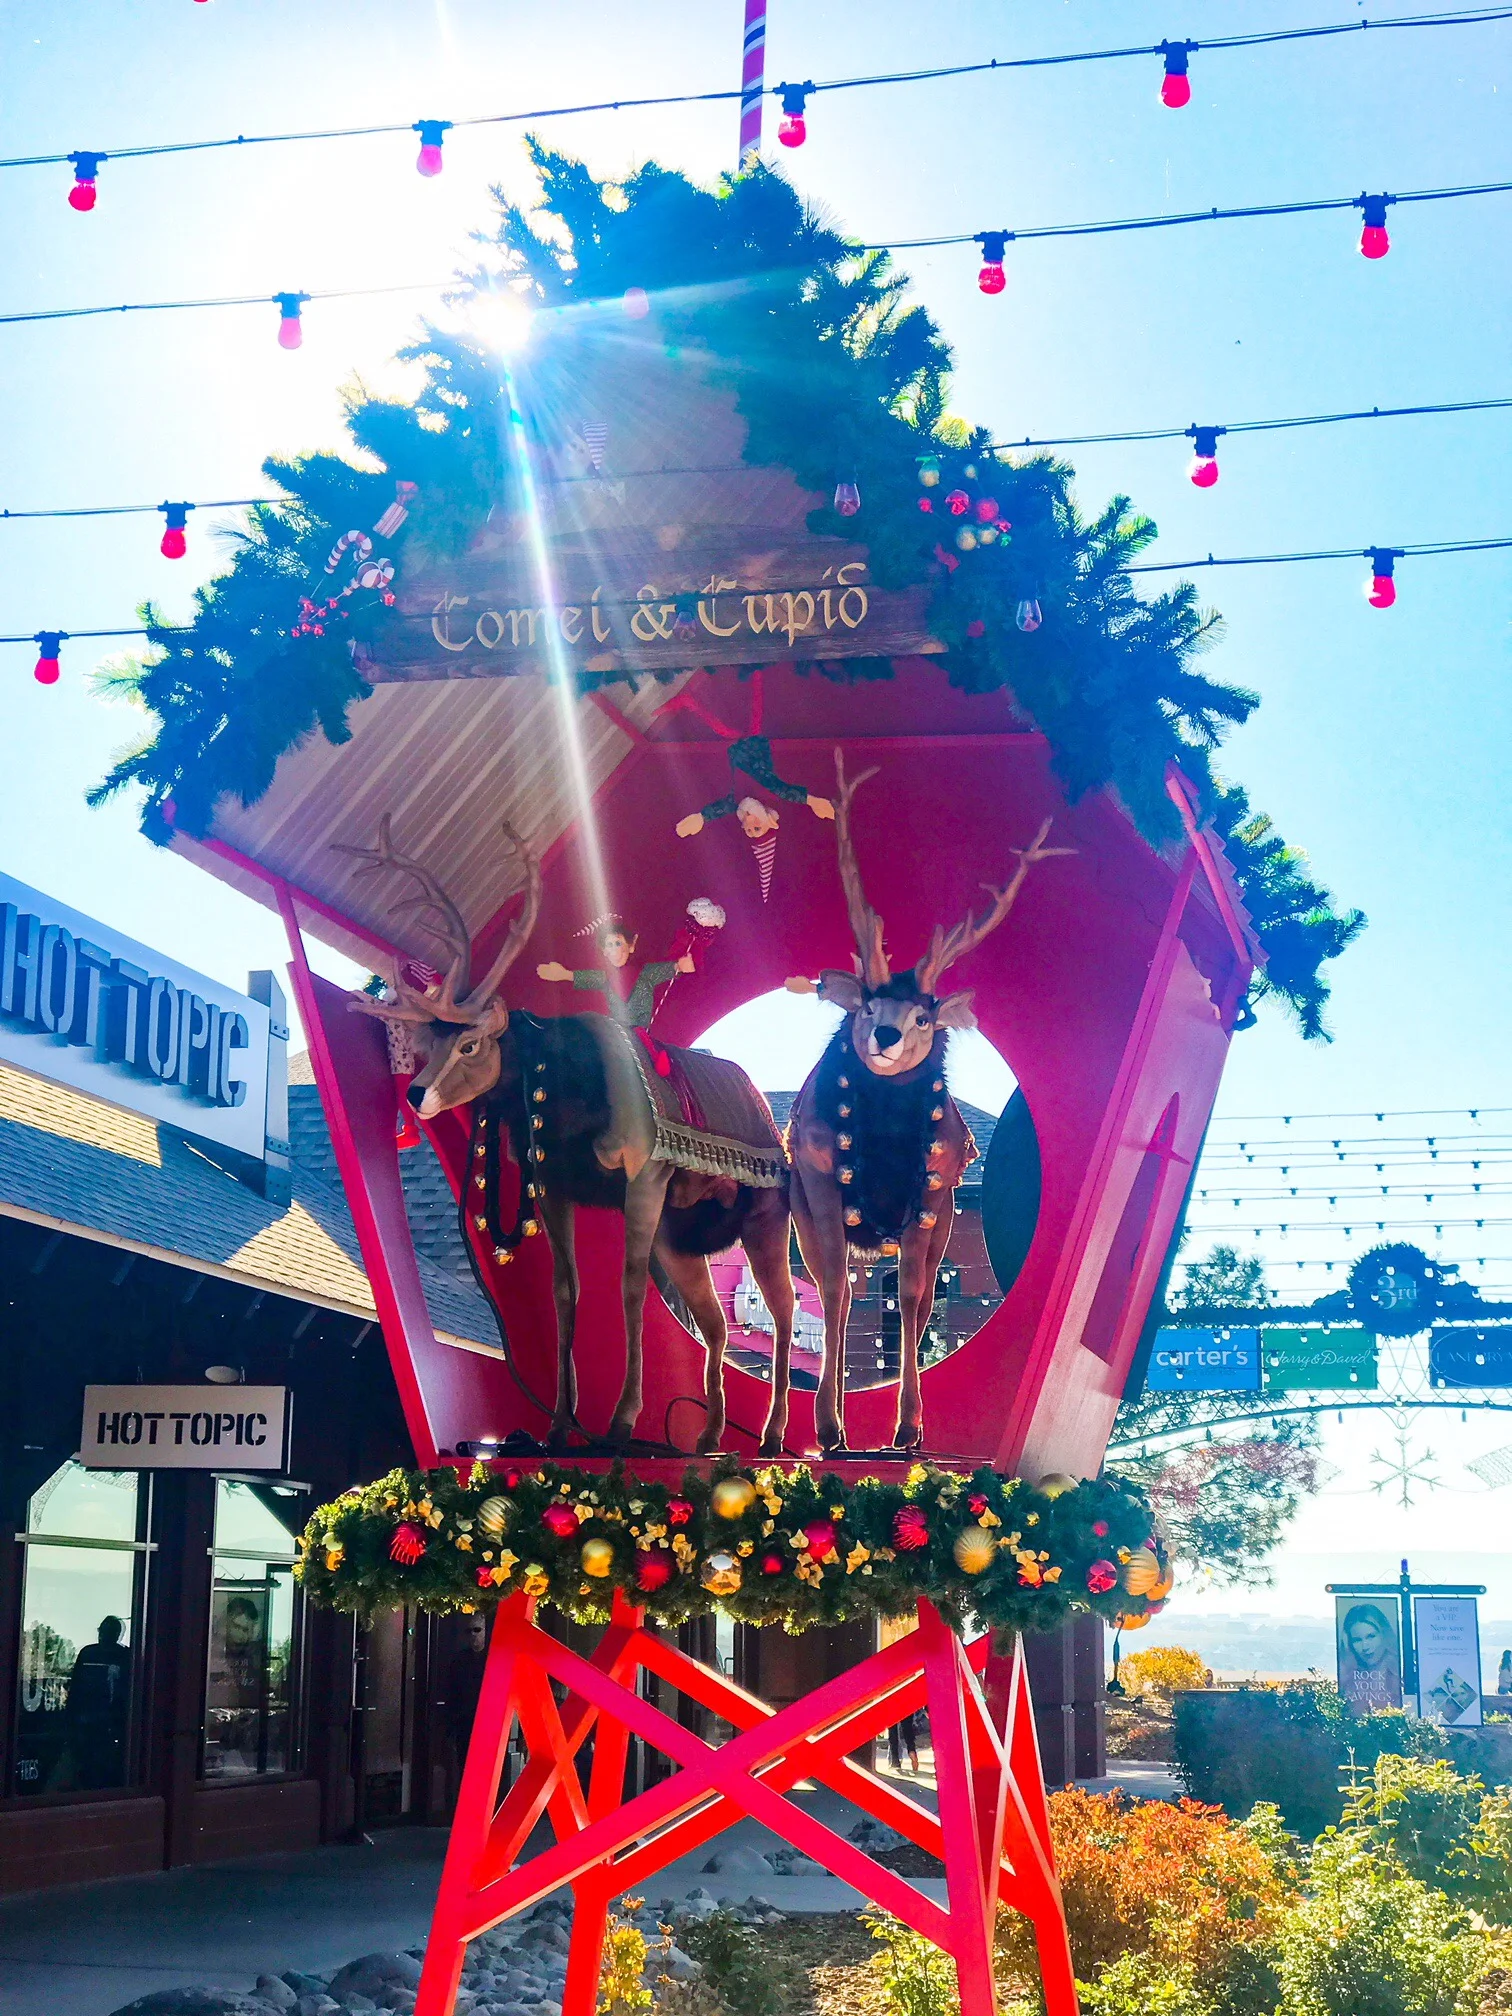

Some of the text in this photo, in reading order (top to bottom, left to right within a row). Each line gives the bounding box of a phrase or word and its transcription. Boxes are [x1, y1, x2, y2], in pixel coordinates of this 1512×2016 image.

[630, 583, 677, 642] &
[696, 562, 870, 648] Cupid
[0, 902, 250, 1108] HOT TOPIC
[1376, 1275, 1418, 1310] 3rd
[1155, 1344, 1249, 1367] carter's
[96, 1411, 268, 1447] HOT TOPIC
[1430, 1623, 1447, 1631] Now
[1432, 1633, 1445, 1641] like
[1353, 1669, 1386, 1681] ROCK
[1353, 1681, 1386, 1691] YOUR
